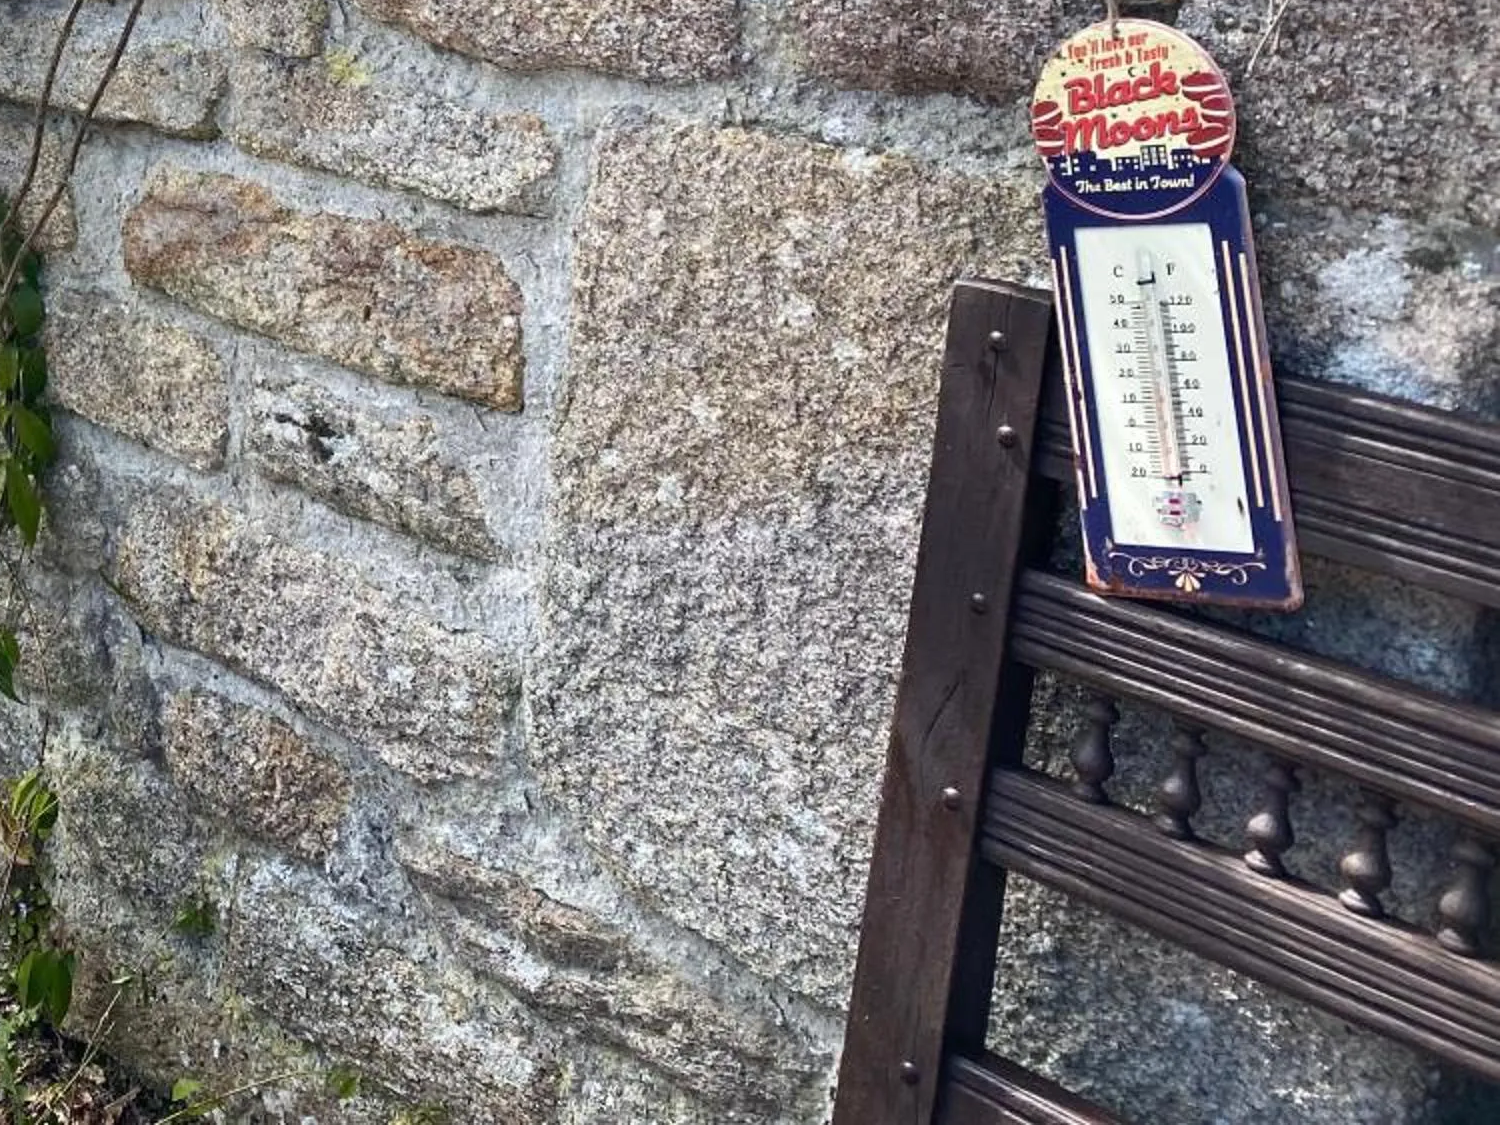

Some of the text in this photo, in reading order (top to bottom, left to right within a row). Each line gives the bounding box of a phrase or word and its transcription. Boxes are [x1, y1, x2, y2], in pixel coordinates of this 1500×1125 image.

[1089, 53, 1122, 71] fresh
[1137, 44, 1169, 63] Tasty
[1063, 61, 1180, 115] Black
[1058, 106, 1202, 156] Moons
[1075, 173, 1195, 194] The Best in Town!
[1113, 265, 1123, 278] C
[1122, 393, 1137, 403] 10
[1191, 435, 1207, 445] 20
[1128, 442, 1143, 452] 10
[1131, 466, 1147, 477] 20
